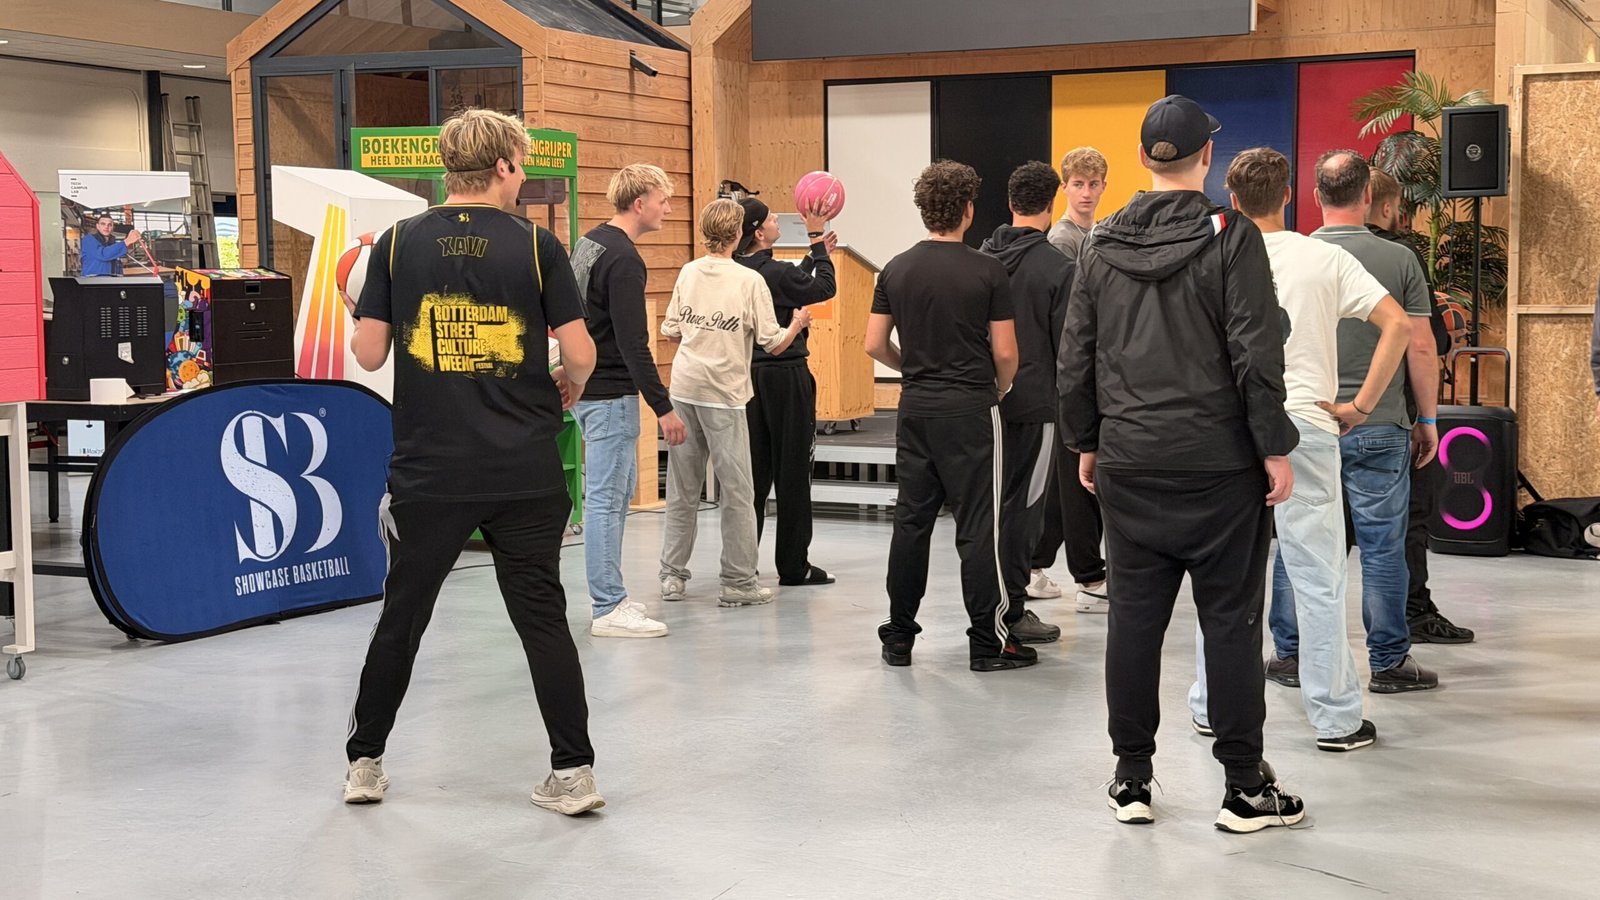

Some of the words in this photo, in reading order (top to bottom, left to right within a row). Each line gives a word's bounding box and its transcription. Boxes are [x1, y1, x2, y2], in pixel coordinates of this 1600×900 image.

[362, 138, 441, 154] BOEKENGR
[370, 156, 391, 165] HEEL
[394, 156, 412, 165] DEN
[415, 155, 441, 165] HAAG
[535, 156, 551, 167] HAAG
[551, 158, 565, 168] LEEST
[437, 236, 488, 257] XAVI
[434, 305, 508, 321] ROTTERDAM
[679, 305, 705, 324] Pure
[706, 311, 740, 332] Path
[436, 322, 478, 338] STREET
[437, 339, 486, 355] CULTURE
[438, 355, 475, 371] WEEK
[1454, 472, 1474, 484] JBL
[234, 566, 291, 597] SHOWCASE
[292, 556, 351, 584] BASKETBALL
